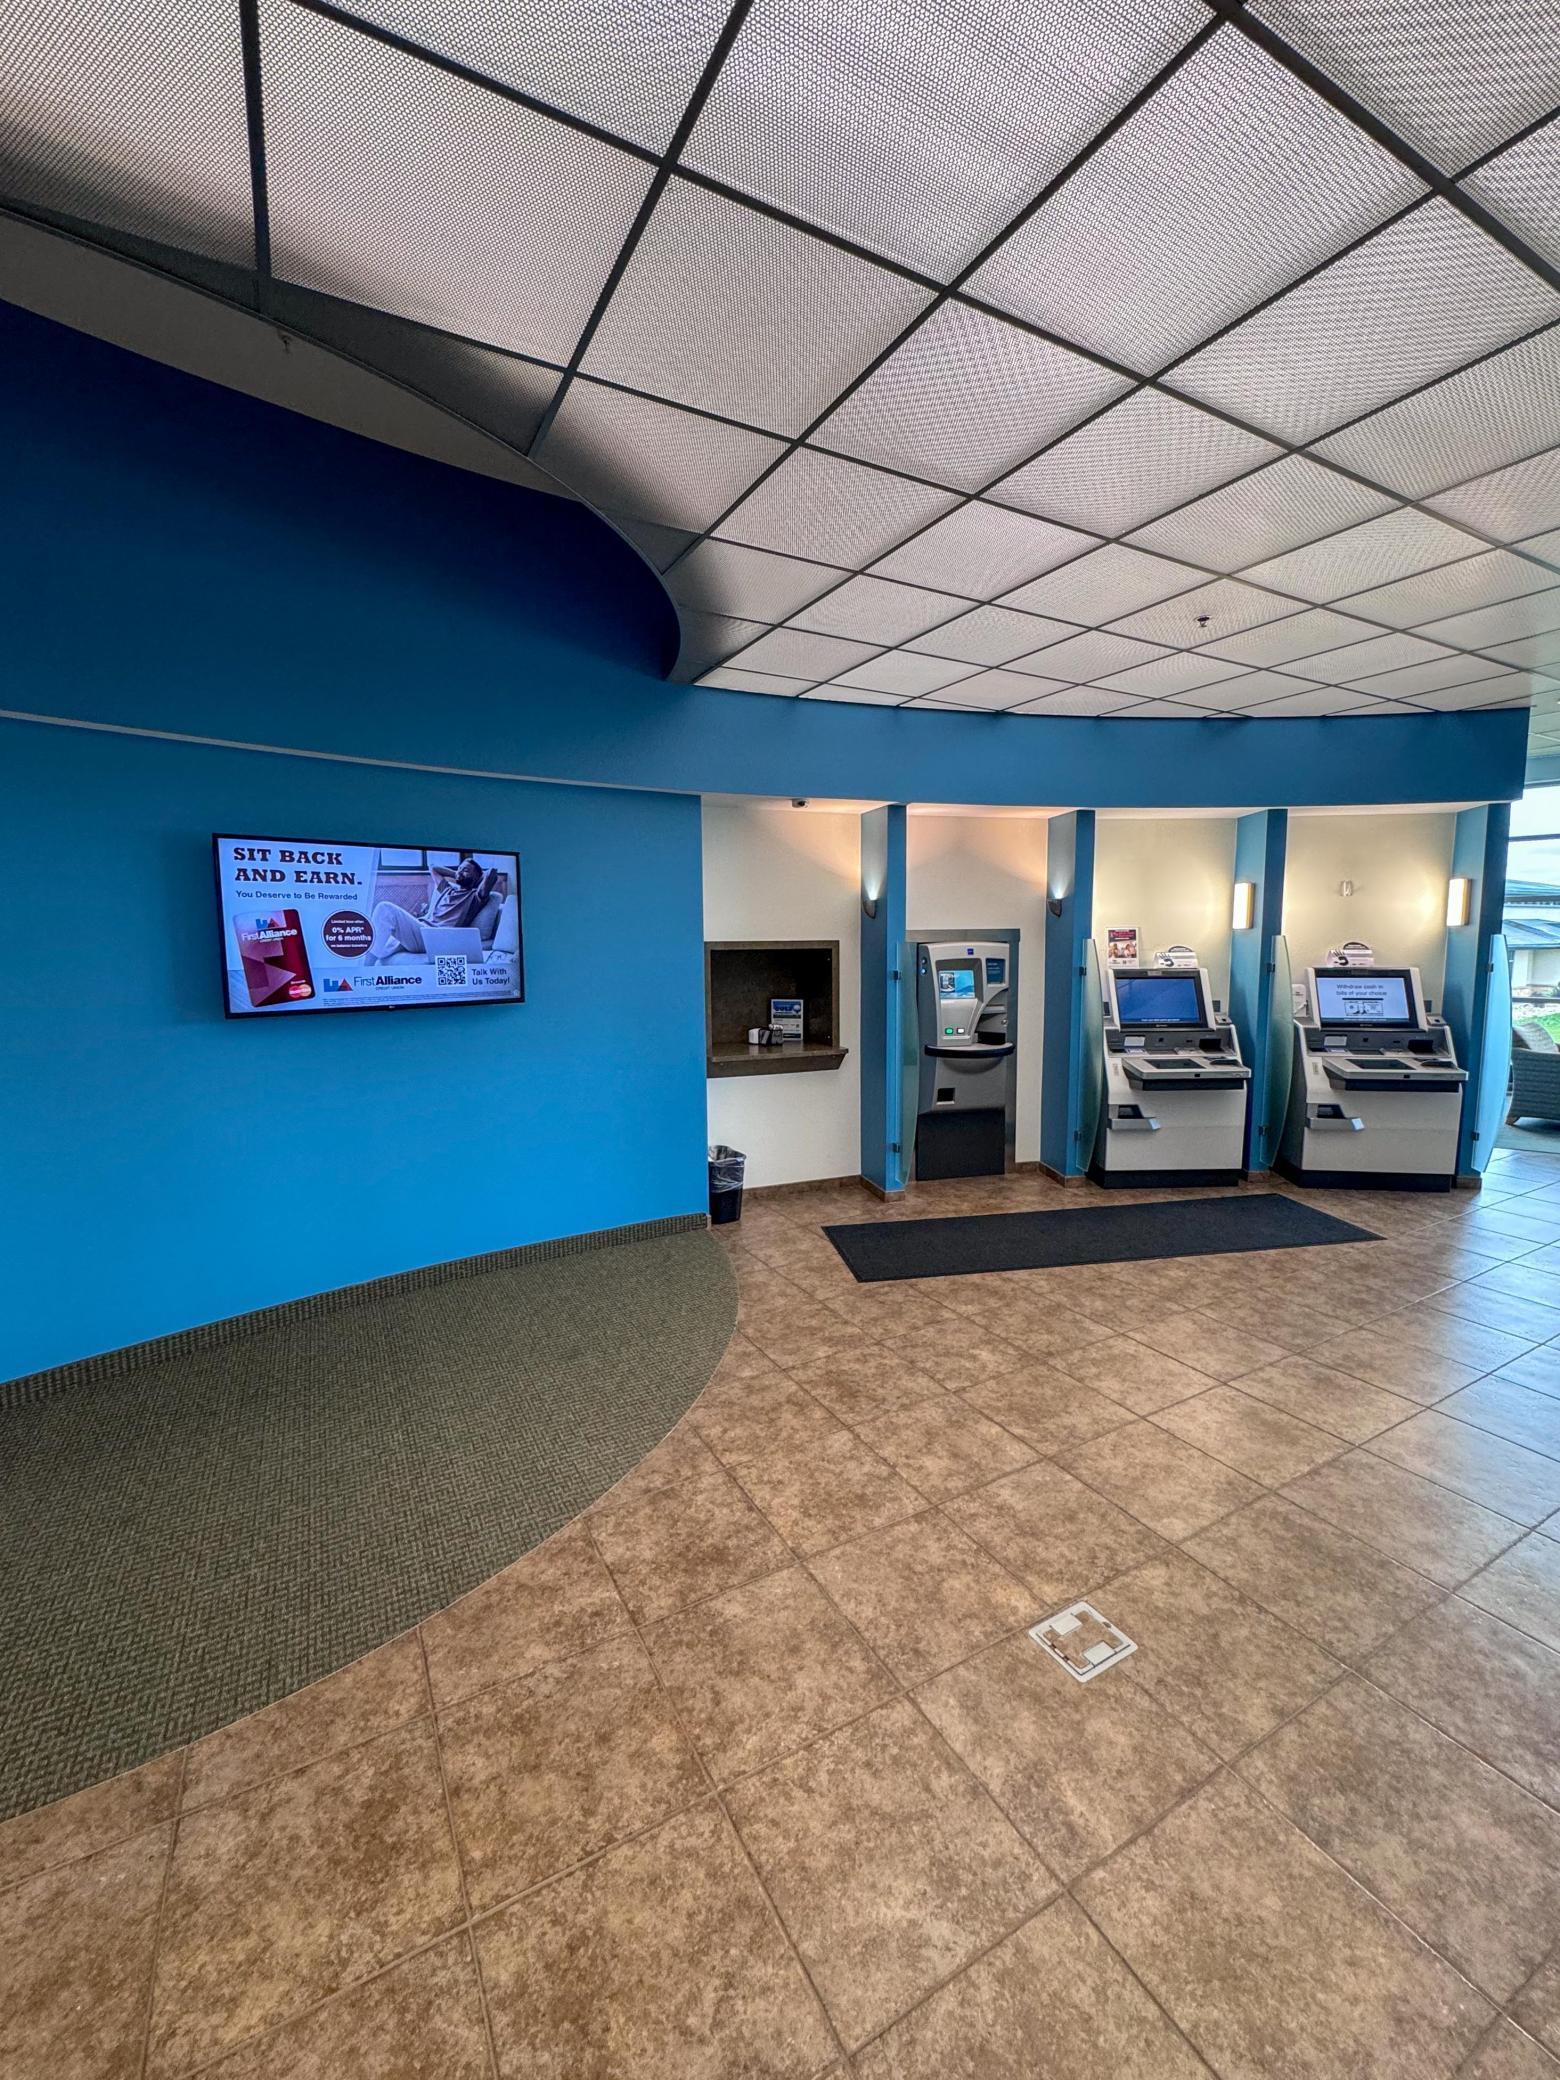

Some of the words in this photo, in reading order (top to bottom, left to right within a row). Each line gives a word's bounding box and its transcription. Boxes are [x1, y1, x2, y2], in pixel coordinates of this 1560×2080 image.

[233, 847, 271, 861] SIT
[279, 850, 343, 865] BACK
[235, 868, 286, 883] AND
[294, 870, 362, 885] EARN.
[236, 890, 253, 899] You
[255, 890, 291, 899] Deserve
[318, 892, 358, 900] Rewarded
[472, 968, 487, 976] Talk
[490, 967, 507, 975] With
[472, 978, 483, 986] Us
[486, 977, 510, 986] Today!
